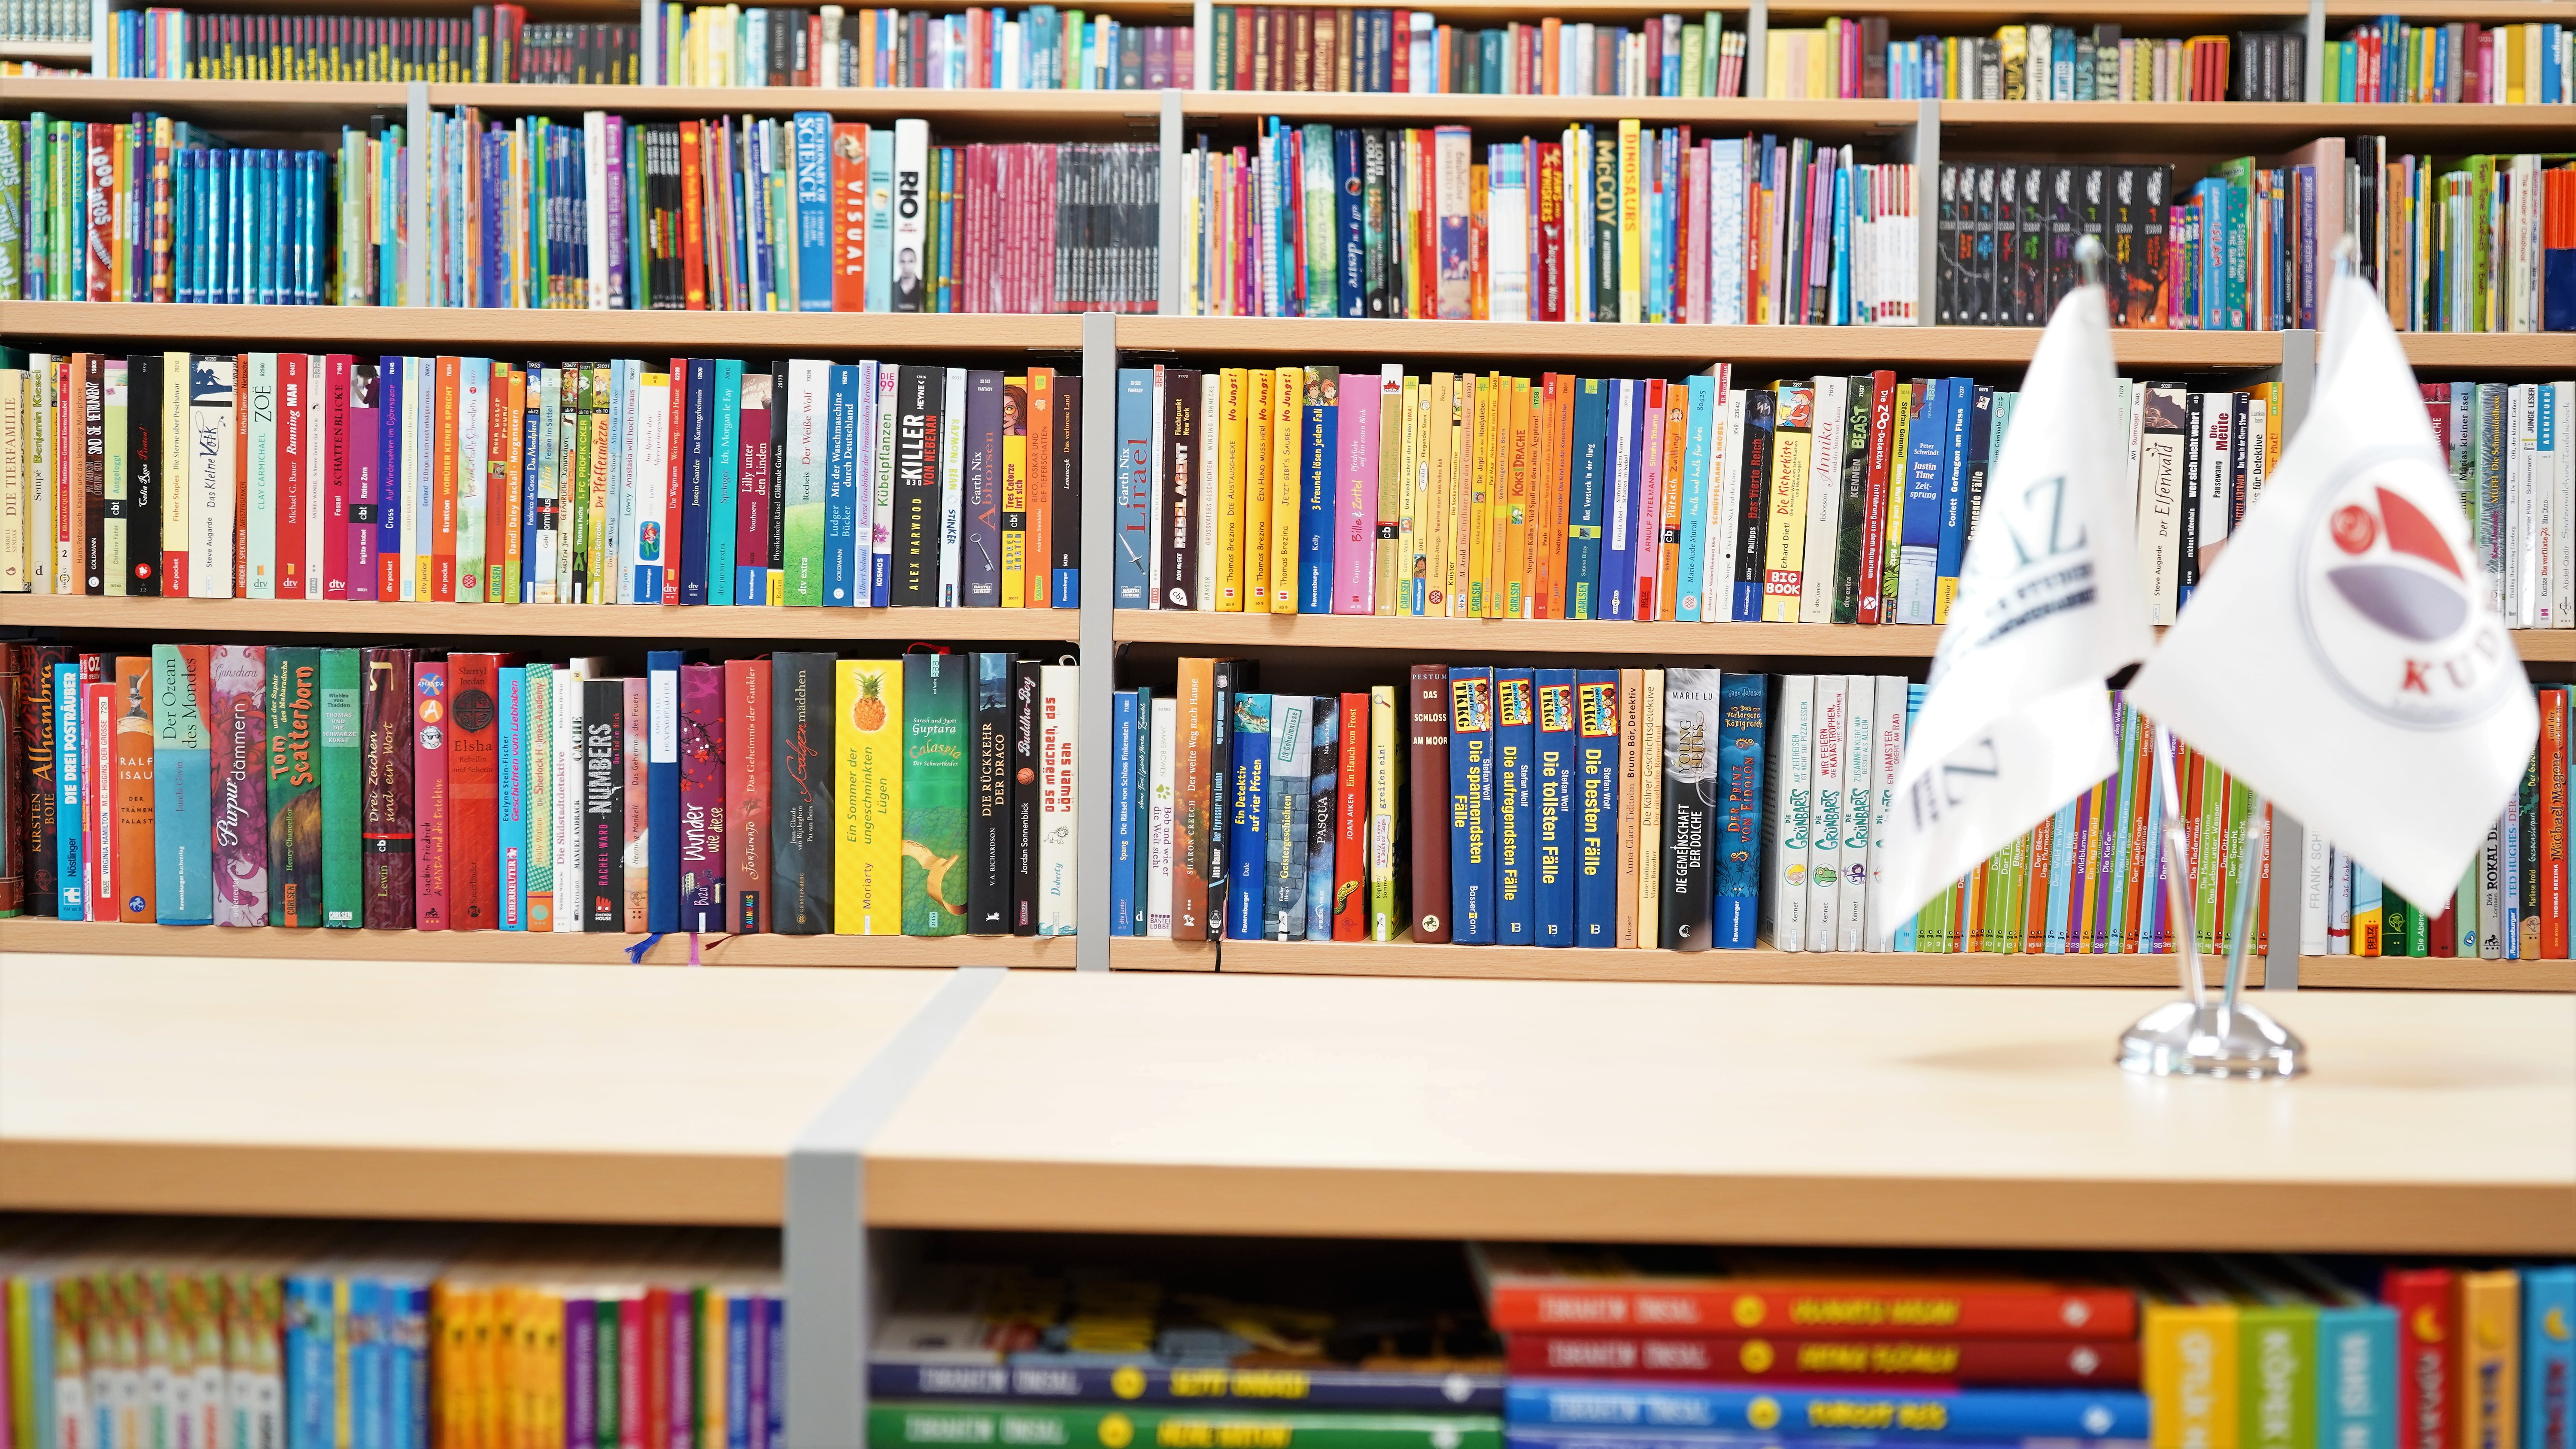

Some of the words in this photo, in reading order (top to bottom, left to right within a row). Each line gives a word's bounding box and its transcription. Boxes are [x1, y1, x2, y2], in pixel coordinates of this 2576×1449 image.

[796, 117, 816, 204] SCIENCE
[816, 117, 826, 187] DICTIONARY
[899, 172, 918, 218] RIO
[1541, 168, 1553, 222] WHISKERS
[1623, 132, 1637, 232] DINOSAURS
[834, 179, 845, 276] DICTIONARY
[846, 179, 863, 275] VISUAL
[2210, 221, 2223, 268] ISLAM
[1347, 240, 1364, 288] desire
[32, 369, 42, 407] Kiesel
[253, 386, 271, 422] ZOË
[1313, 409, 1322, 421] Fall
[1851, 406, 1869, 449] BEAST
[2209, 425, 2218, 439] Die
[2216, 413, 2229, 451] Meute
[2542, 391, 2551, 445] ABENTEUER
[5, 398, 15, 488] TIERFAMILIE
[33, 412, 42, 463] Benjamin
[901, 415, 924, 479] KILLER
[923, 415, 936, 461] NEBENAN
[1313, 424, 1323, 447] jeden
[1956, 434, 1961, 448] am
[756, 443, 766, 475] Linden
[877, 413, 892, 507] Kübelpflanzen
[923, 463, 935, 485] VON
[972, 452, 981, 471] Nix
[1312, 449, 1321, 468] lösen
[1914, 462, 1936, 472] Justin
[1951, 451, 1961, 492] Gefangen
[34, 470, 43, 500] Sempé
[742, 472, 754, 492] Lilly
[756, 479, 765, 495] den
[972, 475, 981, 504] Garth
[978, 432, 995, 531] Abhorsen
[1126, 438, 1147, 534] Lirael
[1312, 471, 1321, 503] Freunde
[1850, 458, 1861, 498] KENNEN
[2213, 461, 2223, 498] Pausewang
[6, 493, 16, 516] DIE
[111, 502, 119, 515] cbt
[1949, 498, 1957, 527] Corlett
[911, 499, 921, 554] MARWOOD
[491, 565, 501, 595] CARLSEN
[909, 563, 919, 590] ALEX
[1766, 583, 1801, 595] BOOK
[1770, 571, 1798, 582] BIG
[1576, 582, 1588, 616] CARLSEN
[162, 659, 176, 706] Ozean
[182, 657, 197, 718] Mondes
[1413, 673, 1448, 681] PESTUM
[61, 672, 77, 751] POSTRÄUBER
[1424, 691, 1437, 699] DAS
[1455, 683, 1470, 728] TKKG
[1583, 687, 1596, 732] TKKG
[163, 712, 176, 739] Der
[913, 723, 956, 737] Guptara
[1415, 712, 1447, 723] SCHLOSS
[182, 725, 197, 748] des
[454, 740, 492, 751] Elsha
[1425, 736, 1449, 746] MOOR
[1628, 729, 1636, 746] Bär,
[1820, 728, 1828, 758] FEIERN
[64, 753, 77, 781] DREI
[121, 756, 153, 766] RALF
[589, 724, 612, 814] NUMBERS
[847, 748, 857, 767] der
[981, 723, 991, 791] RÜCKKEHR
[995, 735, 1004, 776] DRACO
[1586, 749, 1601, 774] Die
[121, 770, 153, 780] ISAU
[1236, 766, 1246, 807] Detektiv
[1251, 760, 1261, 791] Pfoten
[2551, 751, 2566, 804] Magone
[45, 794, 55, 824] BOIE
[64, 785, 77, 805] DIE
[848, 771, 857, 820] Sommer
[863, 747, 873, 844] ungeschminkten
[878, 779, 888, 814] Lügen
[982, 796, 991, 816] DIE
[995, 781, 1003, 805] DER
[1251, 794, 1260, 812] vier
[1585, 780, 1601, 832] besten
[32, 794, 41, 852] KIRSTEN
[683, 803, 705, 860] Wunder
[847, 825, 856, 842] Ein
[1235, 811, 1244, 824] Ein
[1251, 815, 1259, 832] auf
[1690, 812, 1701, 846] DOLCHE
[2549, 805, 2564, 861] Michael
[598, 825, 608, 849] WARD
[1676, 804, 1689, 876] GEMEINSCHAFT
[2077, 828, 2088, 876] Wildblumen
[2509, 828, 2517, 873] HUGHES
[67, 838, 78, 876] Nöstlinger
[598, 853, 608, 885] RACHEL
[1585, 838, 1600, 875] Fälle
[1689, 848, 1701, 867] DER
[507, 858, 516, 924] UEBERREUTER
[863, 863, 873, 909] Moriarty
[1676, 878, 1687, 893] DIE
[328, 911, 352, 920] CARLSEN
